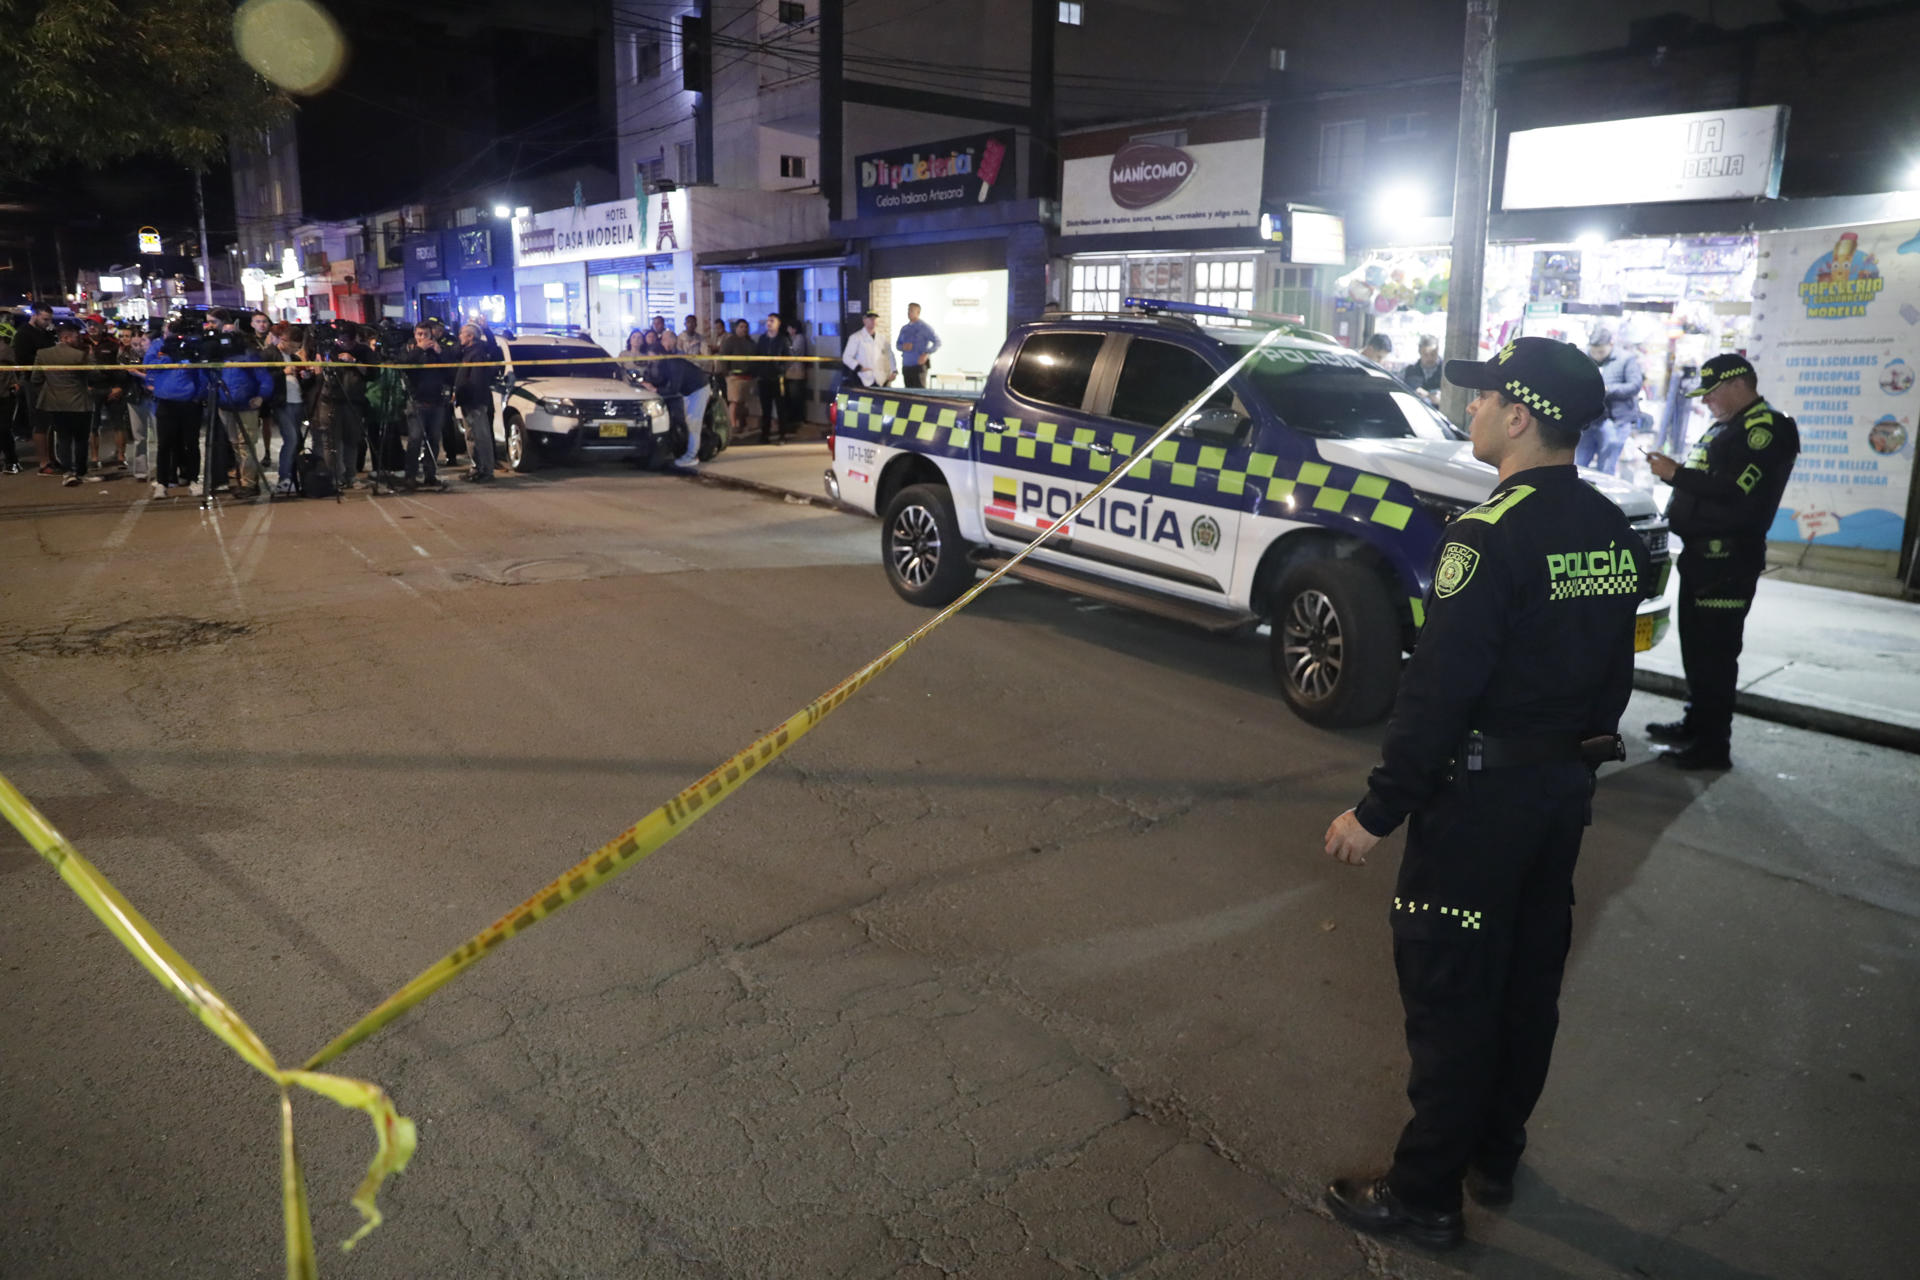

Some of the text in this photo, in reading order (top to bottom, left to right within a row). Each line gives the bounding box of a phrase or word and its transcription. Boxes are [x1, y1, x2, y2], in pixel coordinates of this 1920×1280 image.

[1113, 160, 1187, 184] MANÍCOMIO
[929, 184, 964, 201] Artesanal
[606, 207, 628, 221] HOTEL
[557, 224, 634, 251] CASA MODELIA
[1807, 305, 1866, 318] MODELIA
[1785, 355, 1879, 367] LISTAS ESCOLARES
[1799, 370, 1861, 381] FOTOCOPIAS
[1794, 385, 1862, 396] IMPRESIONES
[1803, 400, 1848, 411] DETALLES
[1824, 459, 1836, 469] DE
[1838, 460, 1879, 470] BELLEZA
[1812, 473, 1838, 483] PARA
[1840, 474, 1850, 484] EL
[1022, 482, 1184, 549] POLICÍA
[1447, 546, 1473, 561] POLICÍA
[1546, 540, 1638, 580] POLICÍA
